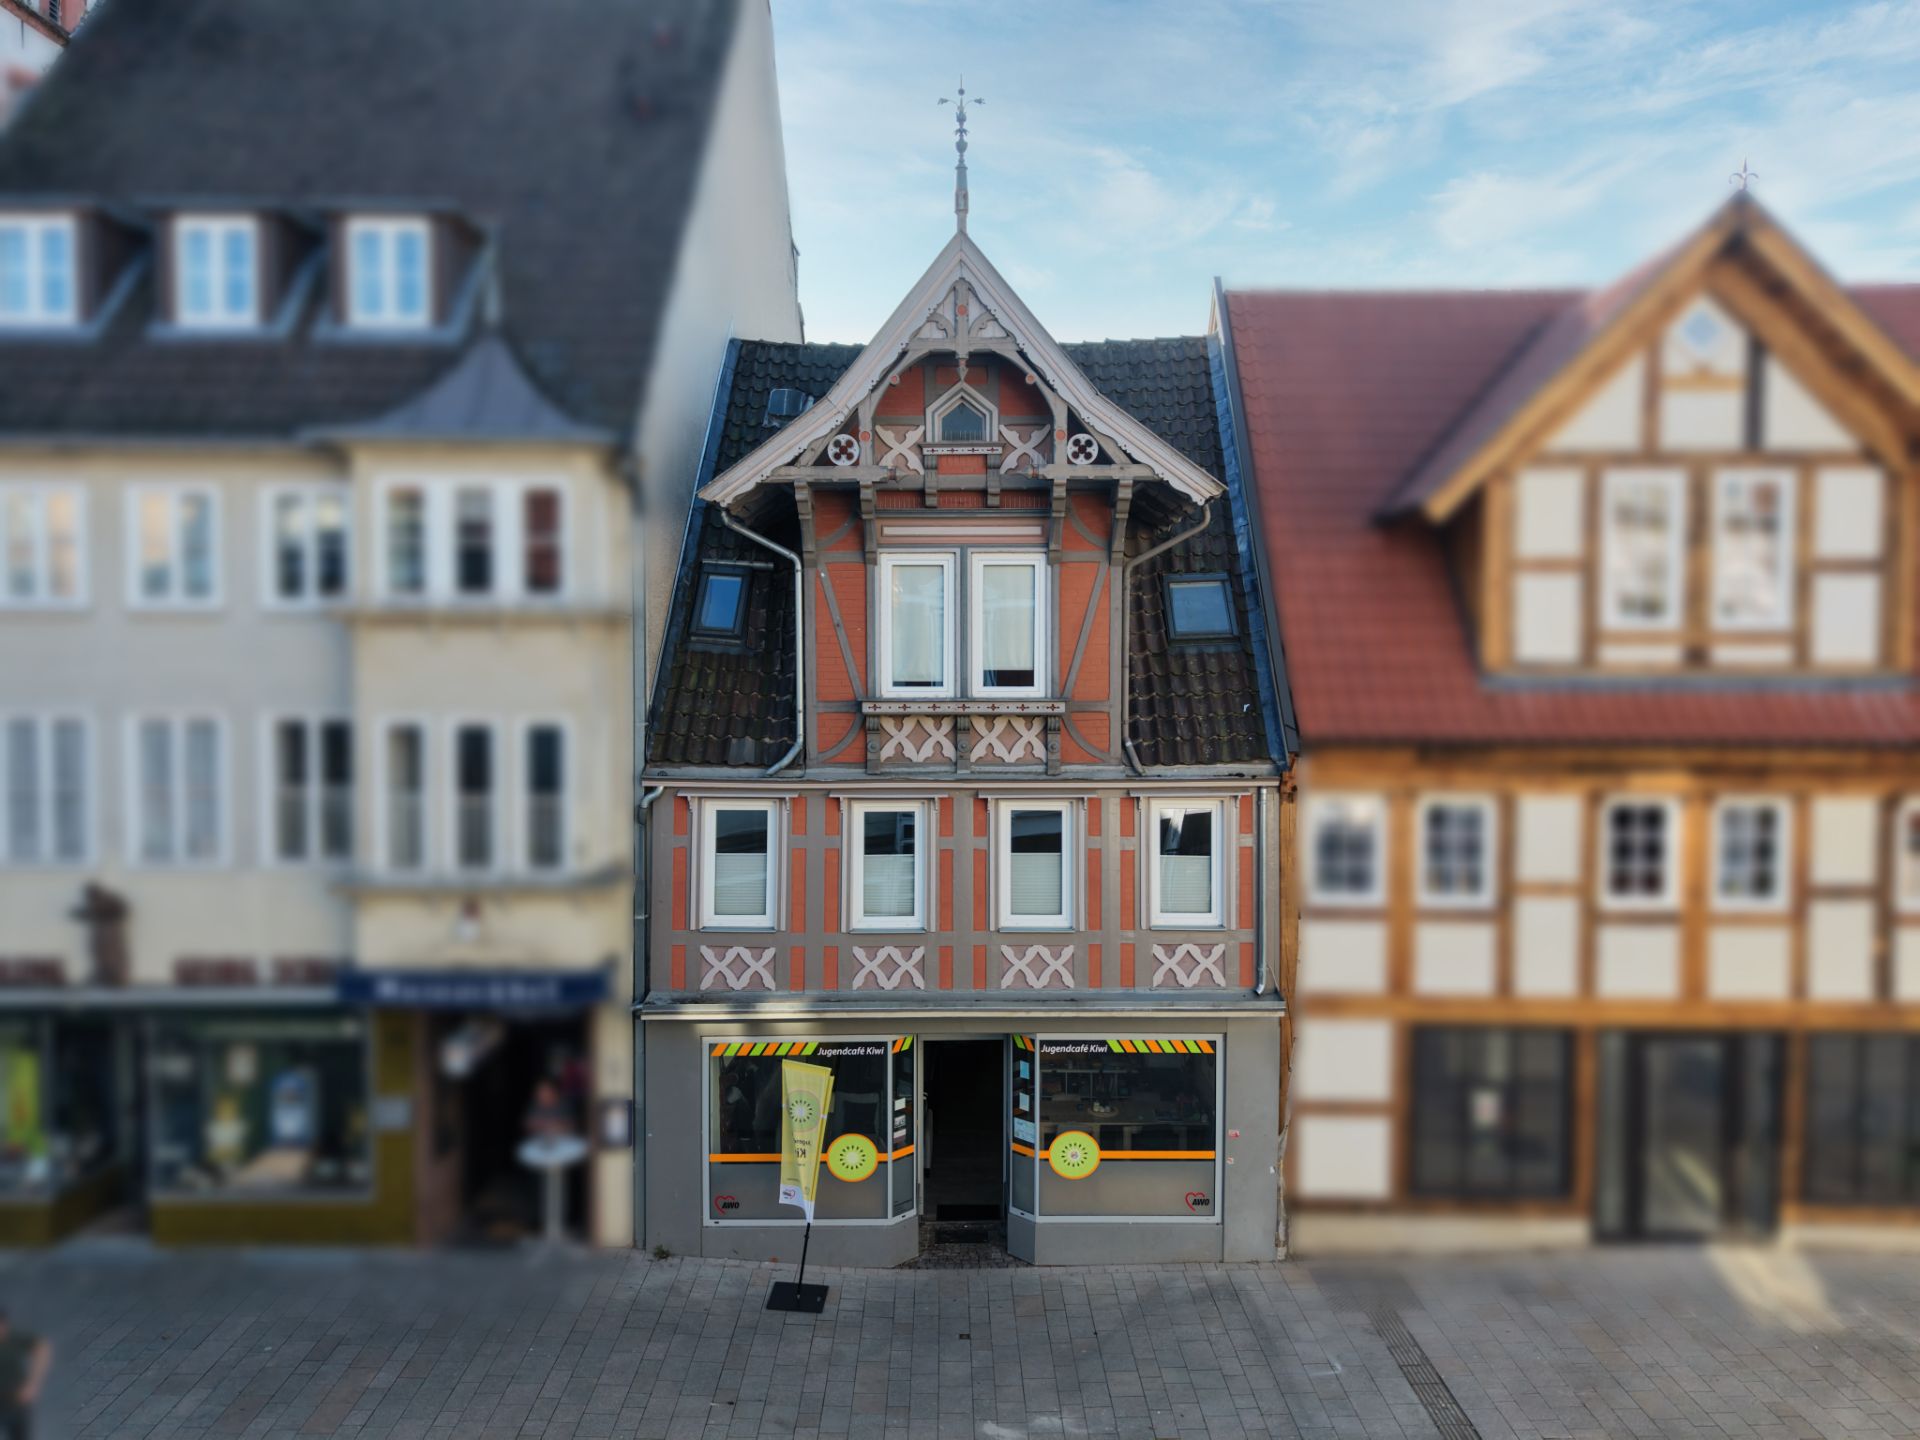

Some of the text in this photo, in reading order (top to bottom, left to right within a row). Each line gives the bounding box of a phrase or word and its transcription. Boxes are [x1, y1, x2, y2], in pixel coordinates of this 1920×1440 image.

[817, 1046, 885, 1057] Jugendcafé Kiwi
[1040, 1043, 1108, 1055] Jugendcafé Kiwi
[721, 1201, 740, 1209] AWO
[1192, 1198, 1210, 1206] AWO
